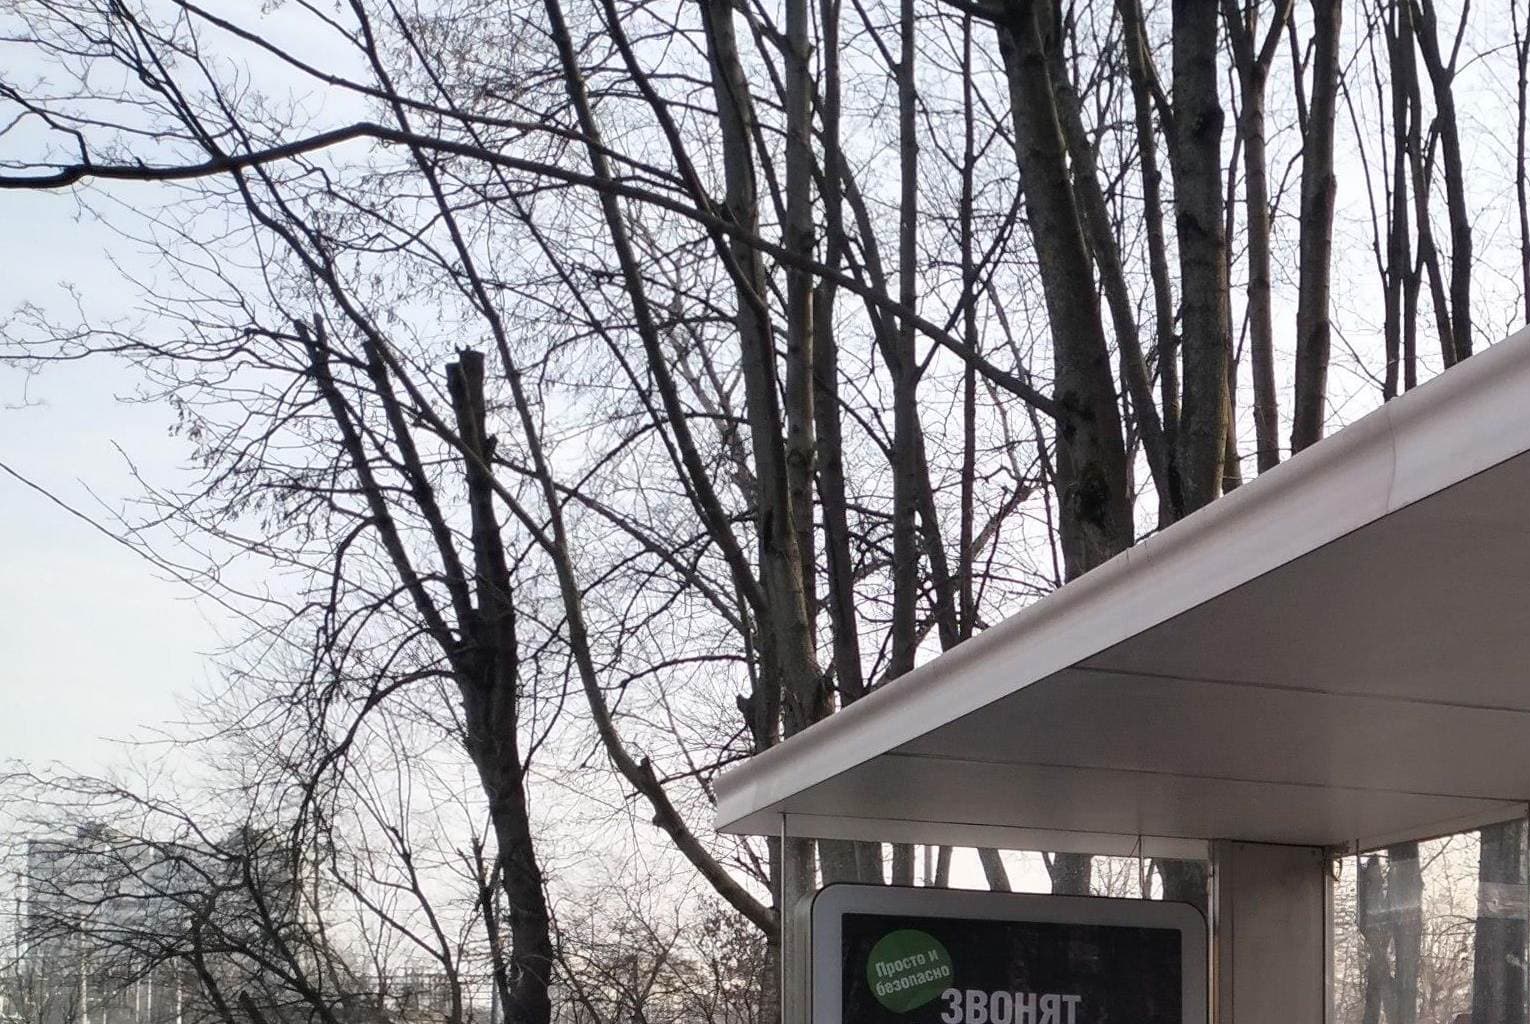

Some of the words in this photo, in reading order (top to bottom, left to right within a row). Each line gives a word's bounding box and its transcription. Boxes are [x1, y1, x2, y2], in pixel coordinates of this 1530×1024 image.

[875, 953, 926, 978] Просто
[928, 949, 939, 962] и
[876, 965, 951, 997] безопасно
